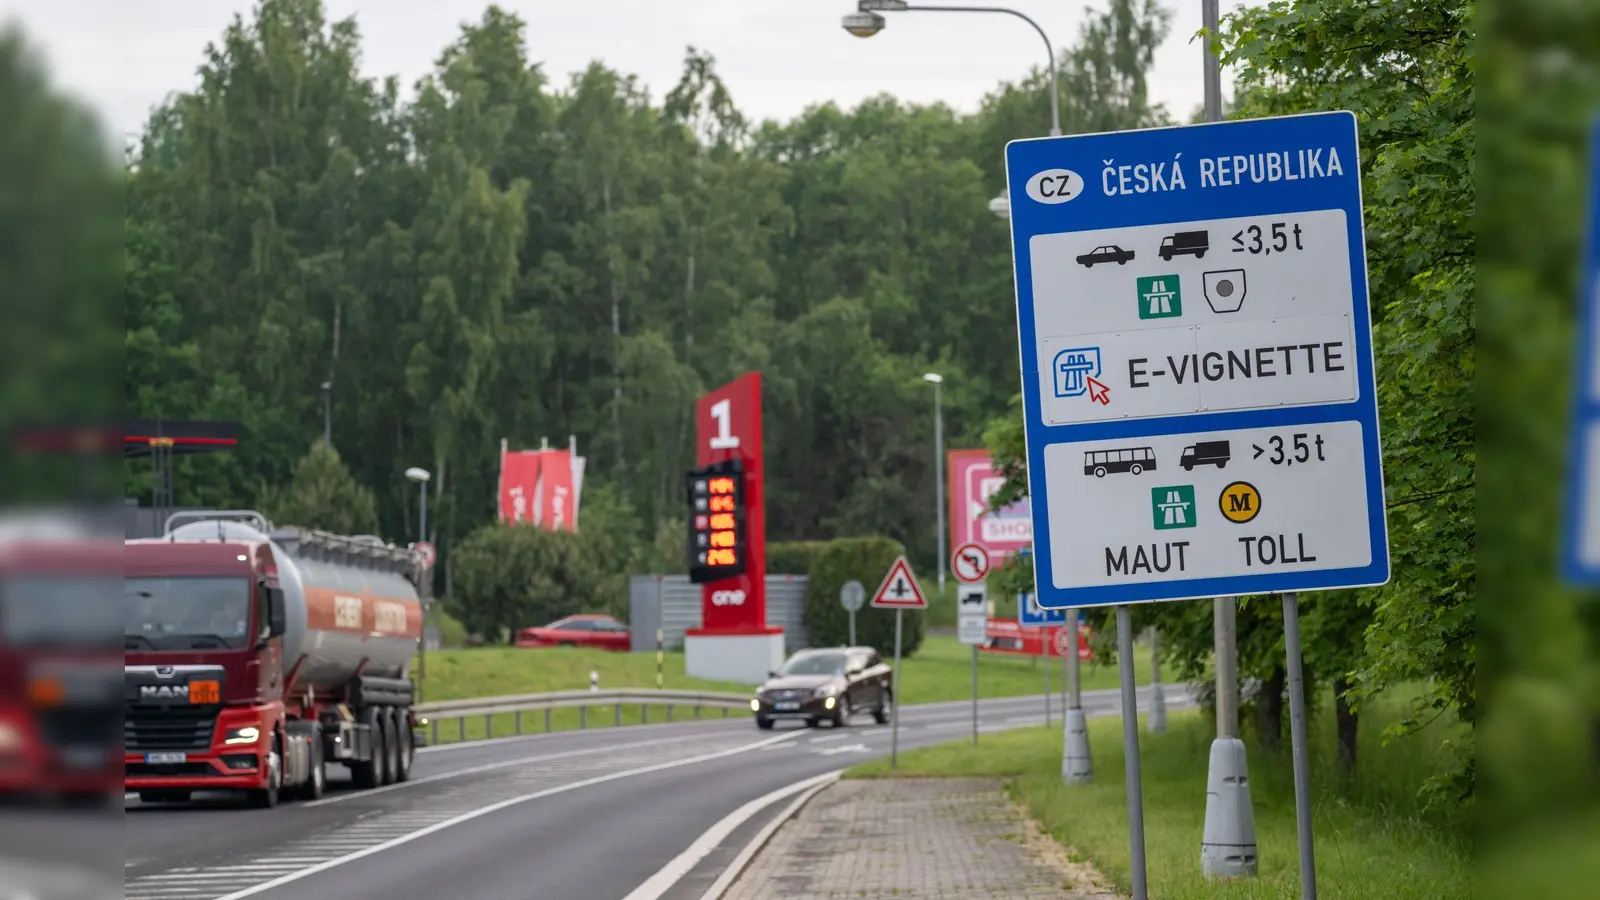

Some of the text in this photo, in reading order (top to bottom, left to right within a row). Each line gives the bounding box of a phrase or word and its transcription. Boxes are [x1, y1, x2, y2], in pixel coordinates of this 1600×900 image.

[1039, 175, 1071, 198] CZ
[1102, 147, 1344, 197] ČESKÁ REPUBLIKA
[1128, 341, 1345, 388] E-VIGNETTE
[710, 400, 739, 449] 1
[1229, 493, 1251, 512] M
[987, 522, 1032, 536] SHO
[1105, 533, 1316, 576] MAUT TOLL
[140, 685, 189, 697] MAN
